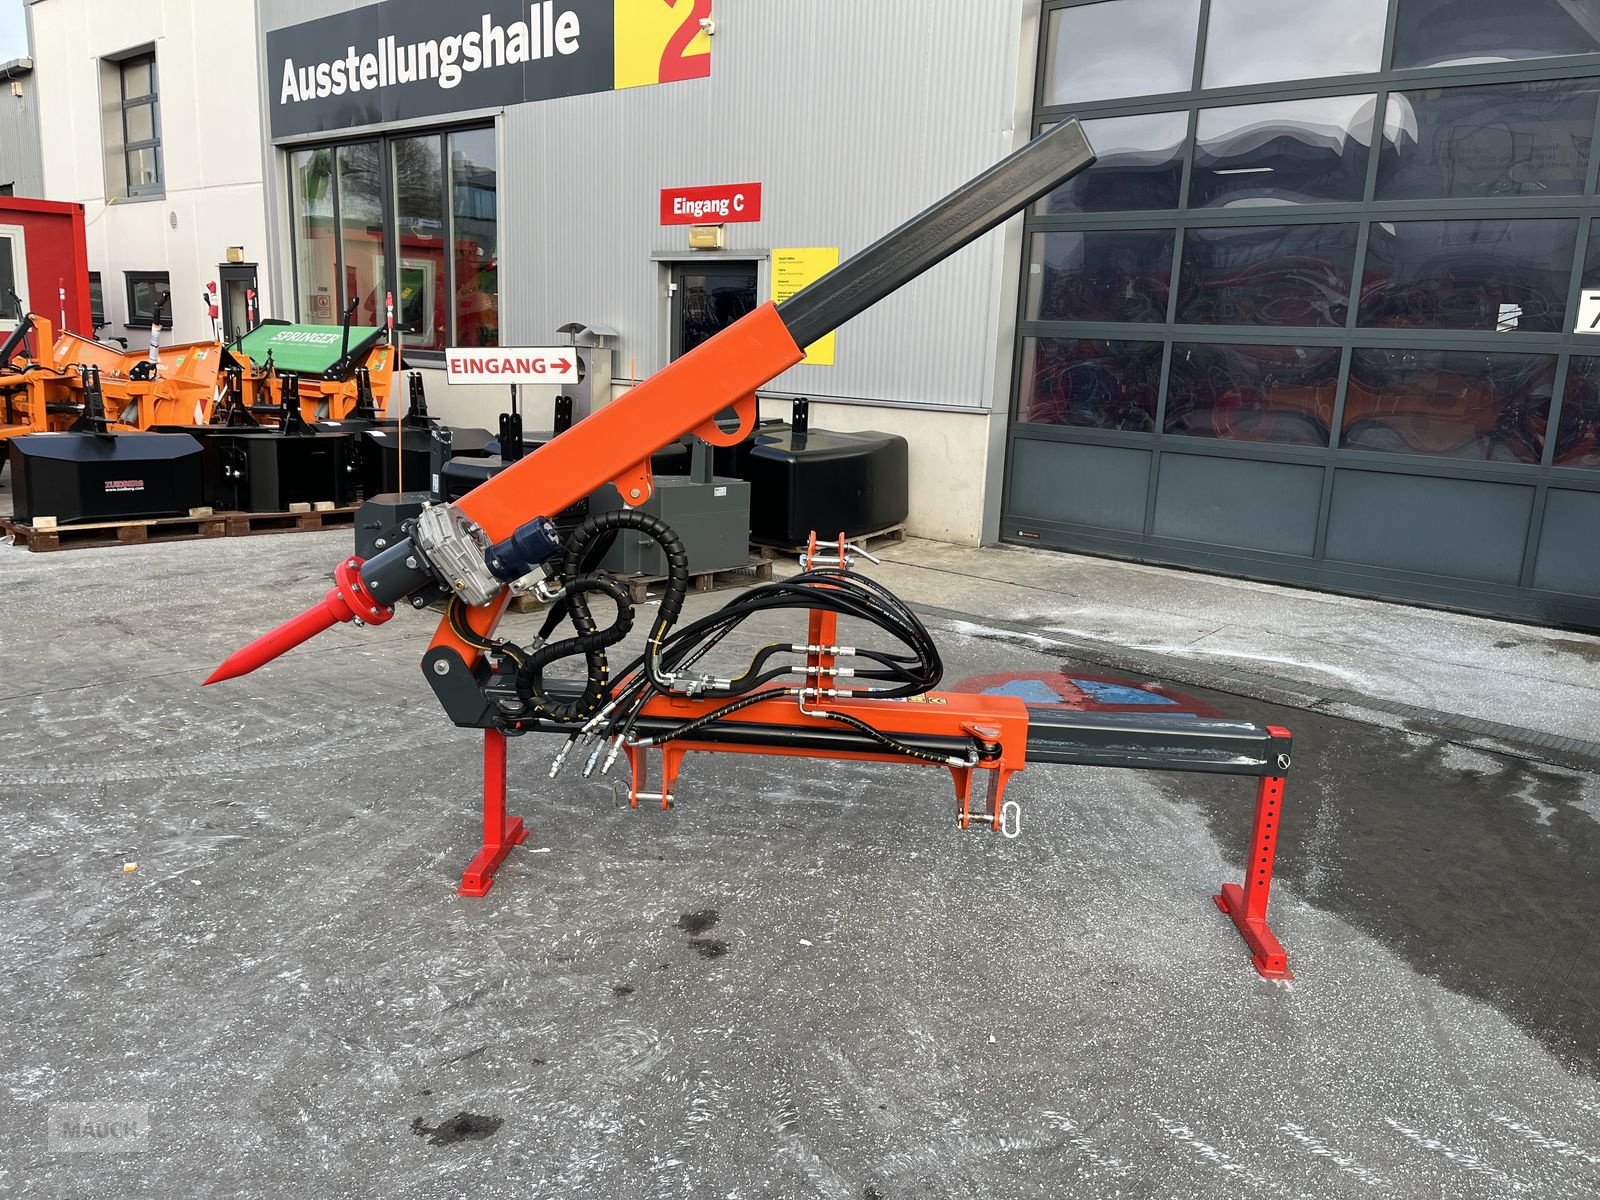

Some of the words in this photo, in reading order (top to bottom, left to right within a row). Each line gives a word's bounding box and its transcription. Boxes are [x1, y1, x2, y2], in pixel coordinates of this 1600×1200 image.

[280, 1, 580, 104] Ausstellungshalle
[658, 0, 712, 84] 2
[673, 197, 730, 217] Eingang
[733, 193, 745, 211] C
[271, 331, 340, 344] SPRINGER
[450, 358, 546, 374] EINGANG
